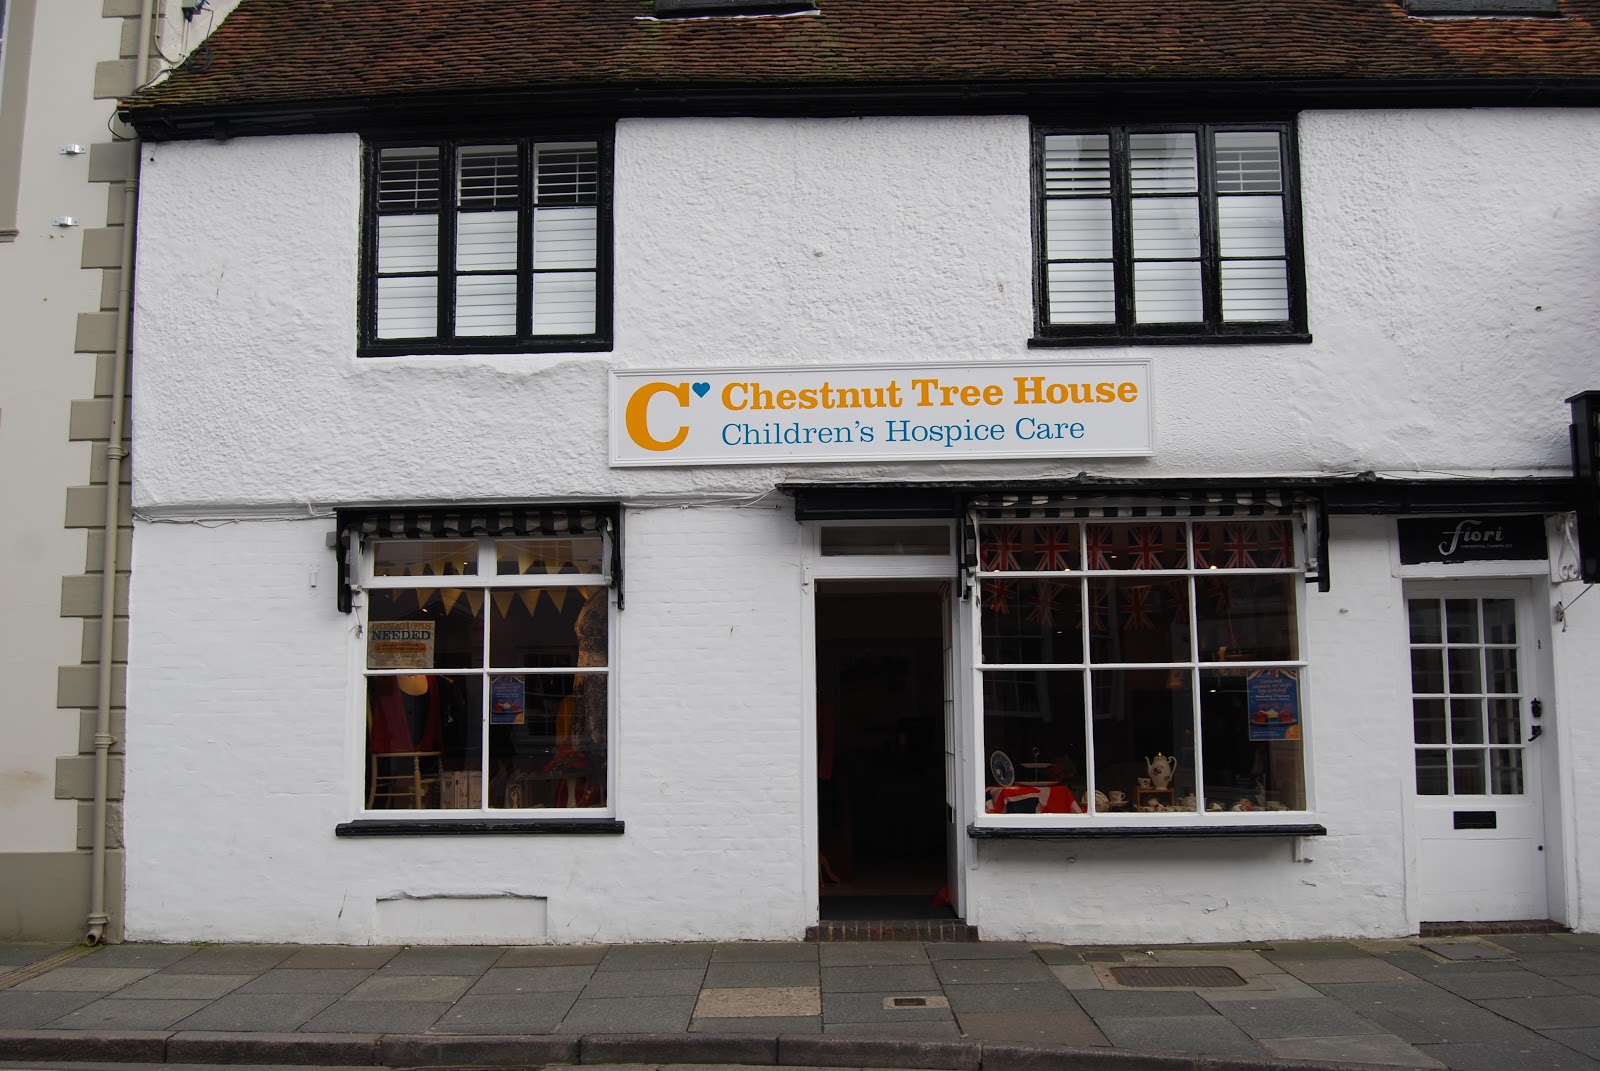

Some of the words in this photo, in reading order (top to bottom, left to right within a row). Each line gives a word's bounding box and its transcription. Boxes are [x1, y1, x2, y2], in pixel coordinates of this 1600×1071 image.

[721, 380, 903, 411] Chestnut
[911, 378, 1003, 407] Tree
[1013, 376, 1138, 405] House
[625, 382, 690, 452] C
[885, 419, 1005, 448] Hospice
[1015, 417, 1085, 440] Care
[371, 622, 433, 630] DONATIONS
[371, 630, 431, 640] NEEDED
